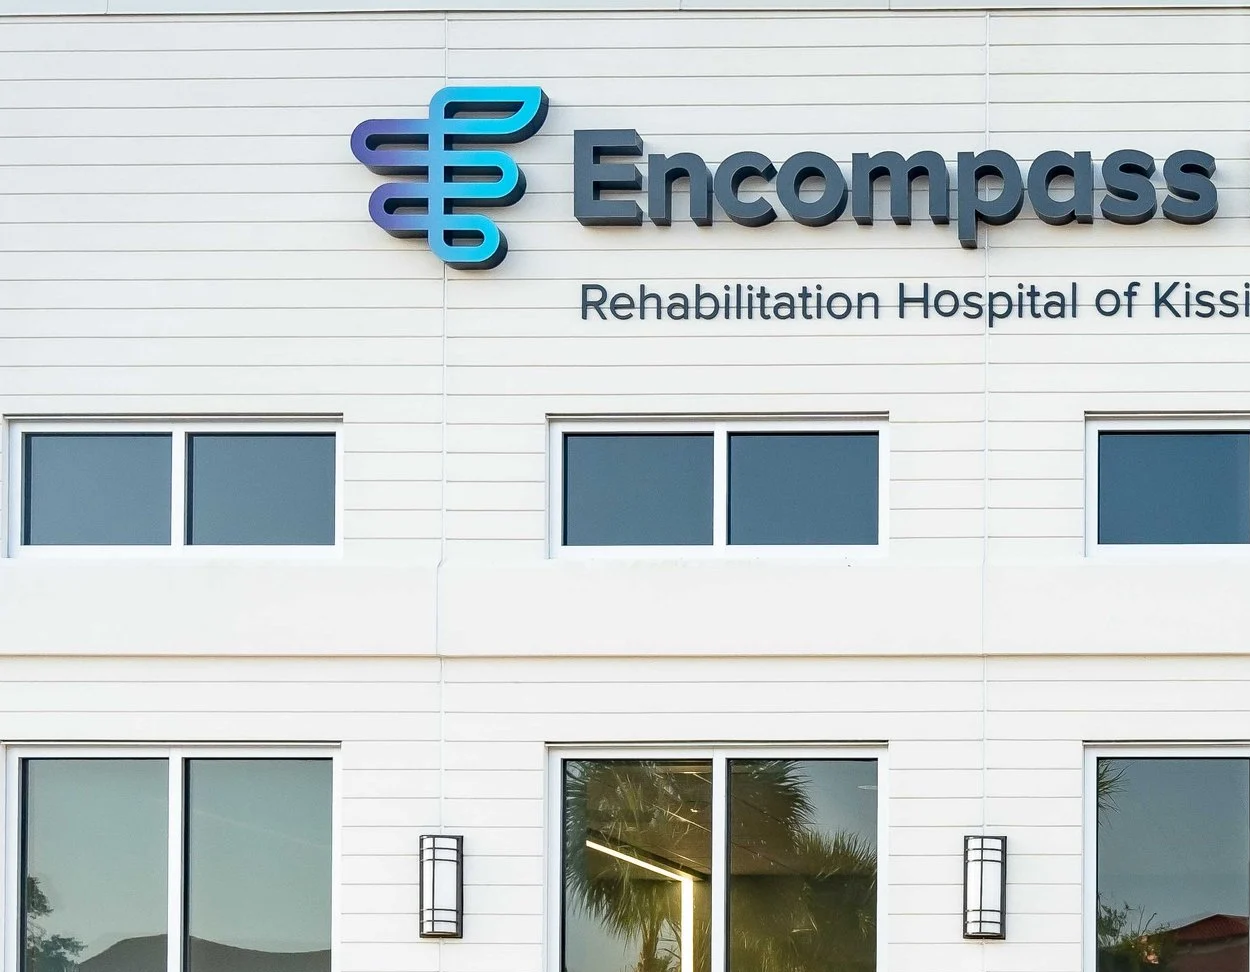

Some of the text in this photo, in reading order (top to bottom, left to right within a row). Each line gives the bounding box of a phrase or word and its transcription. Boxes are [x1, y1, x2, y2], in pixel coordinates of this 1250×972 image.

[573, 128, 1219, 249] Encompass
[581, 282, 879, 321] Rehabilitation
[898, 281, 1077, 328] Hospital
[1095, 281, 1141, 319] of
